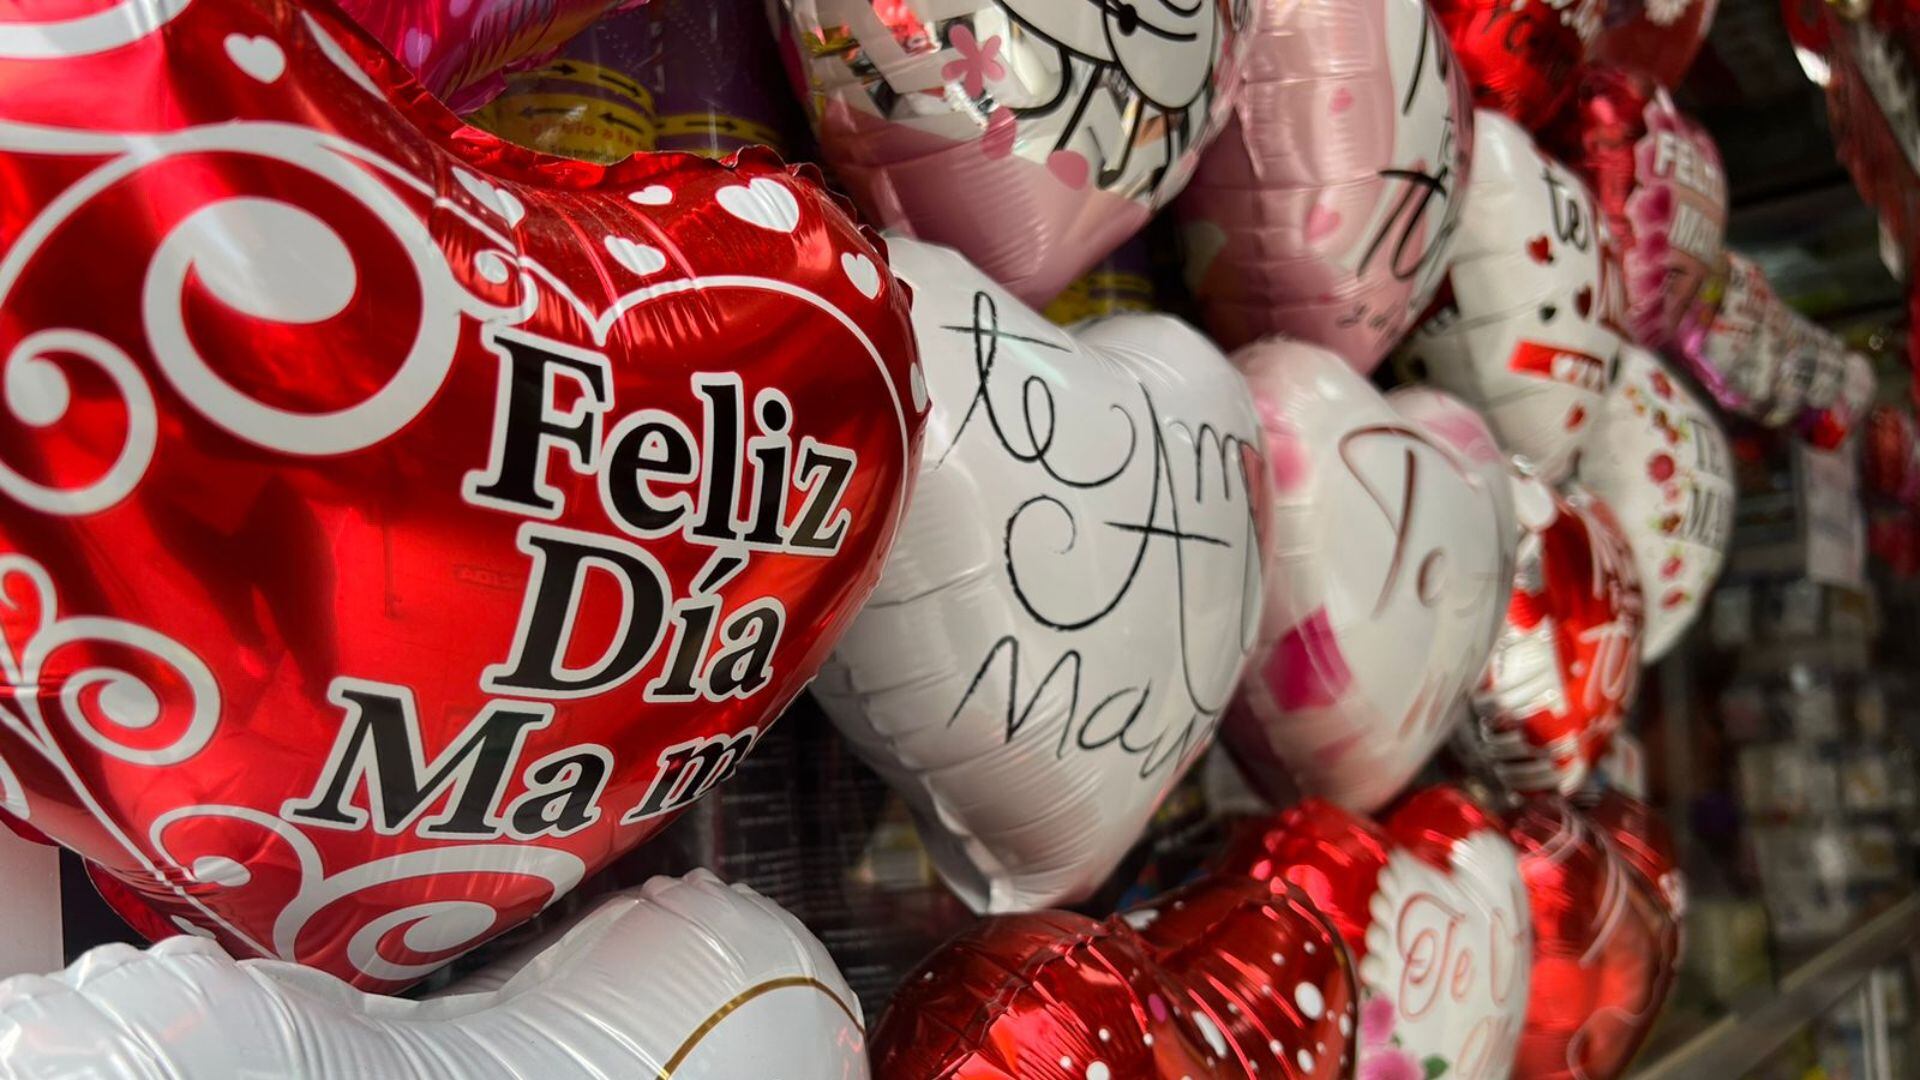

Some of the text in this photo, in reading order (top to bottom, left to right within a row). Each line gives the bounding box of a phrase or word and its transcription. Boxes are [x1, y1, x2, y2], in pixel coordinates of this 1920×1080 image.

[466, 327, 854, 552] Feliz
[937, 291, 1137, 489] te
[485, 526, 782, 700] Día
